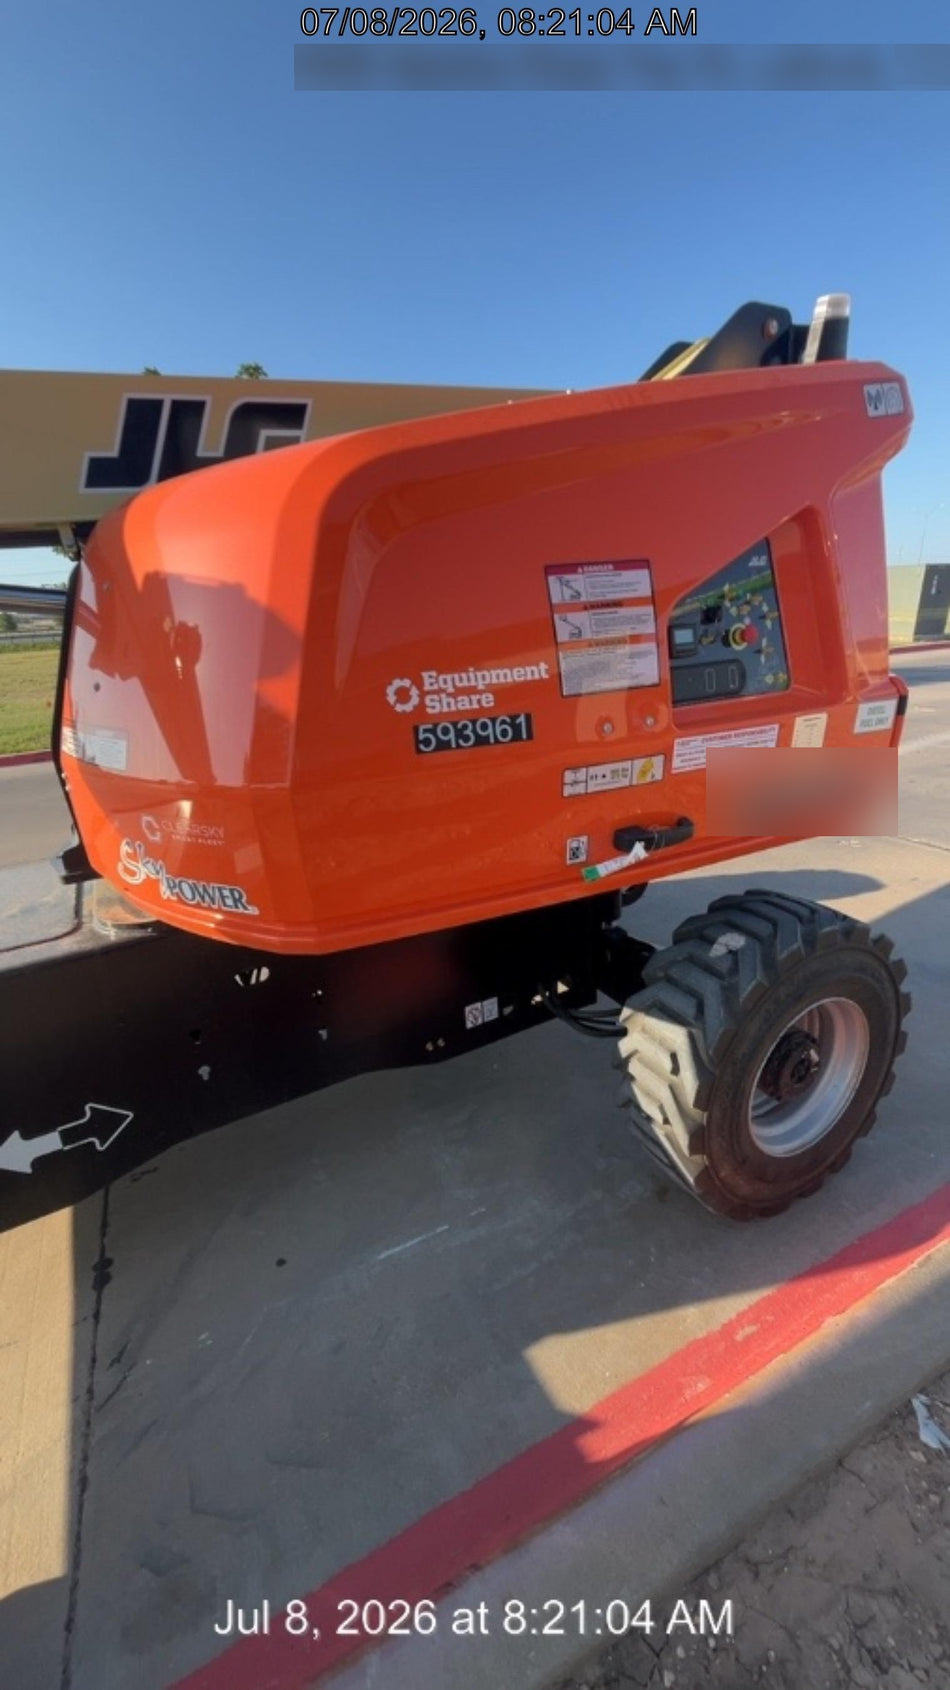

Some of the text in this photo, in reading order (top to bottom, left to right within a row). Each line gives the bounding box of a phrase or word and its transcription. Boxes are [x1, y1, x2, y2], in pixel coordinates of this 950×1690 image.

[421, 662, 549, 692] Equipment
[424, 692, 495, 714] Share
[418, 714, 527, 752] 593961
